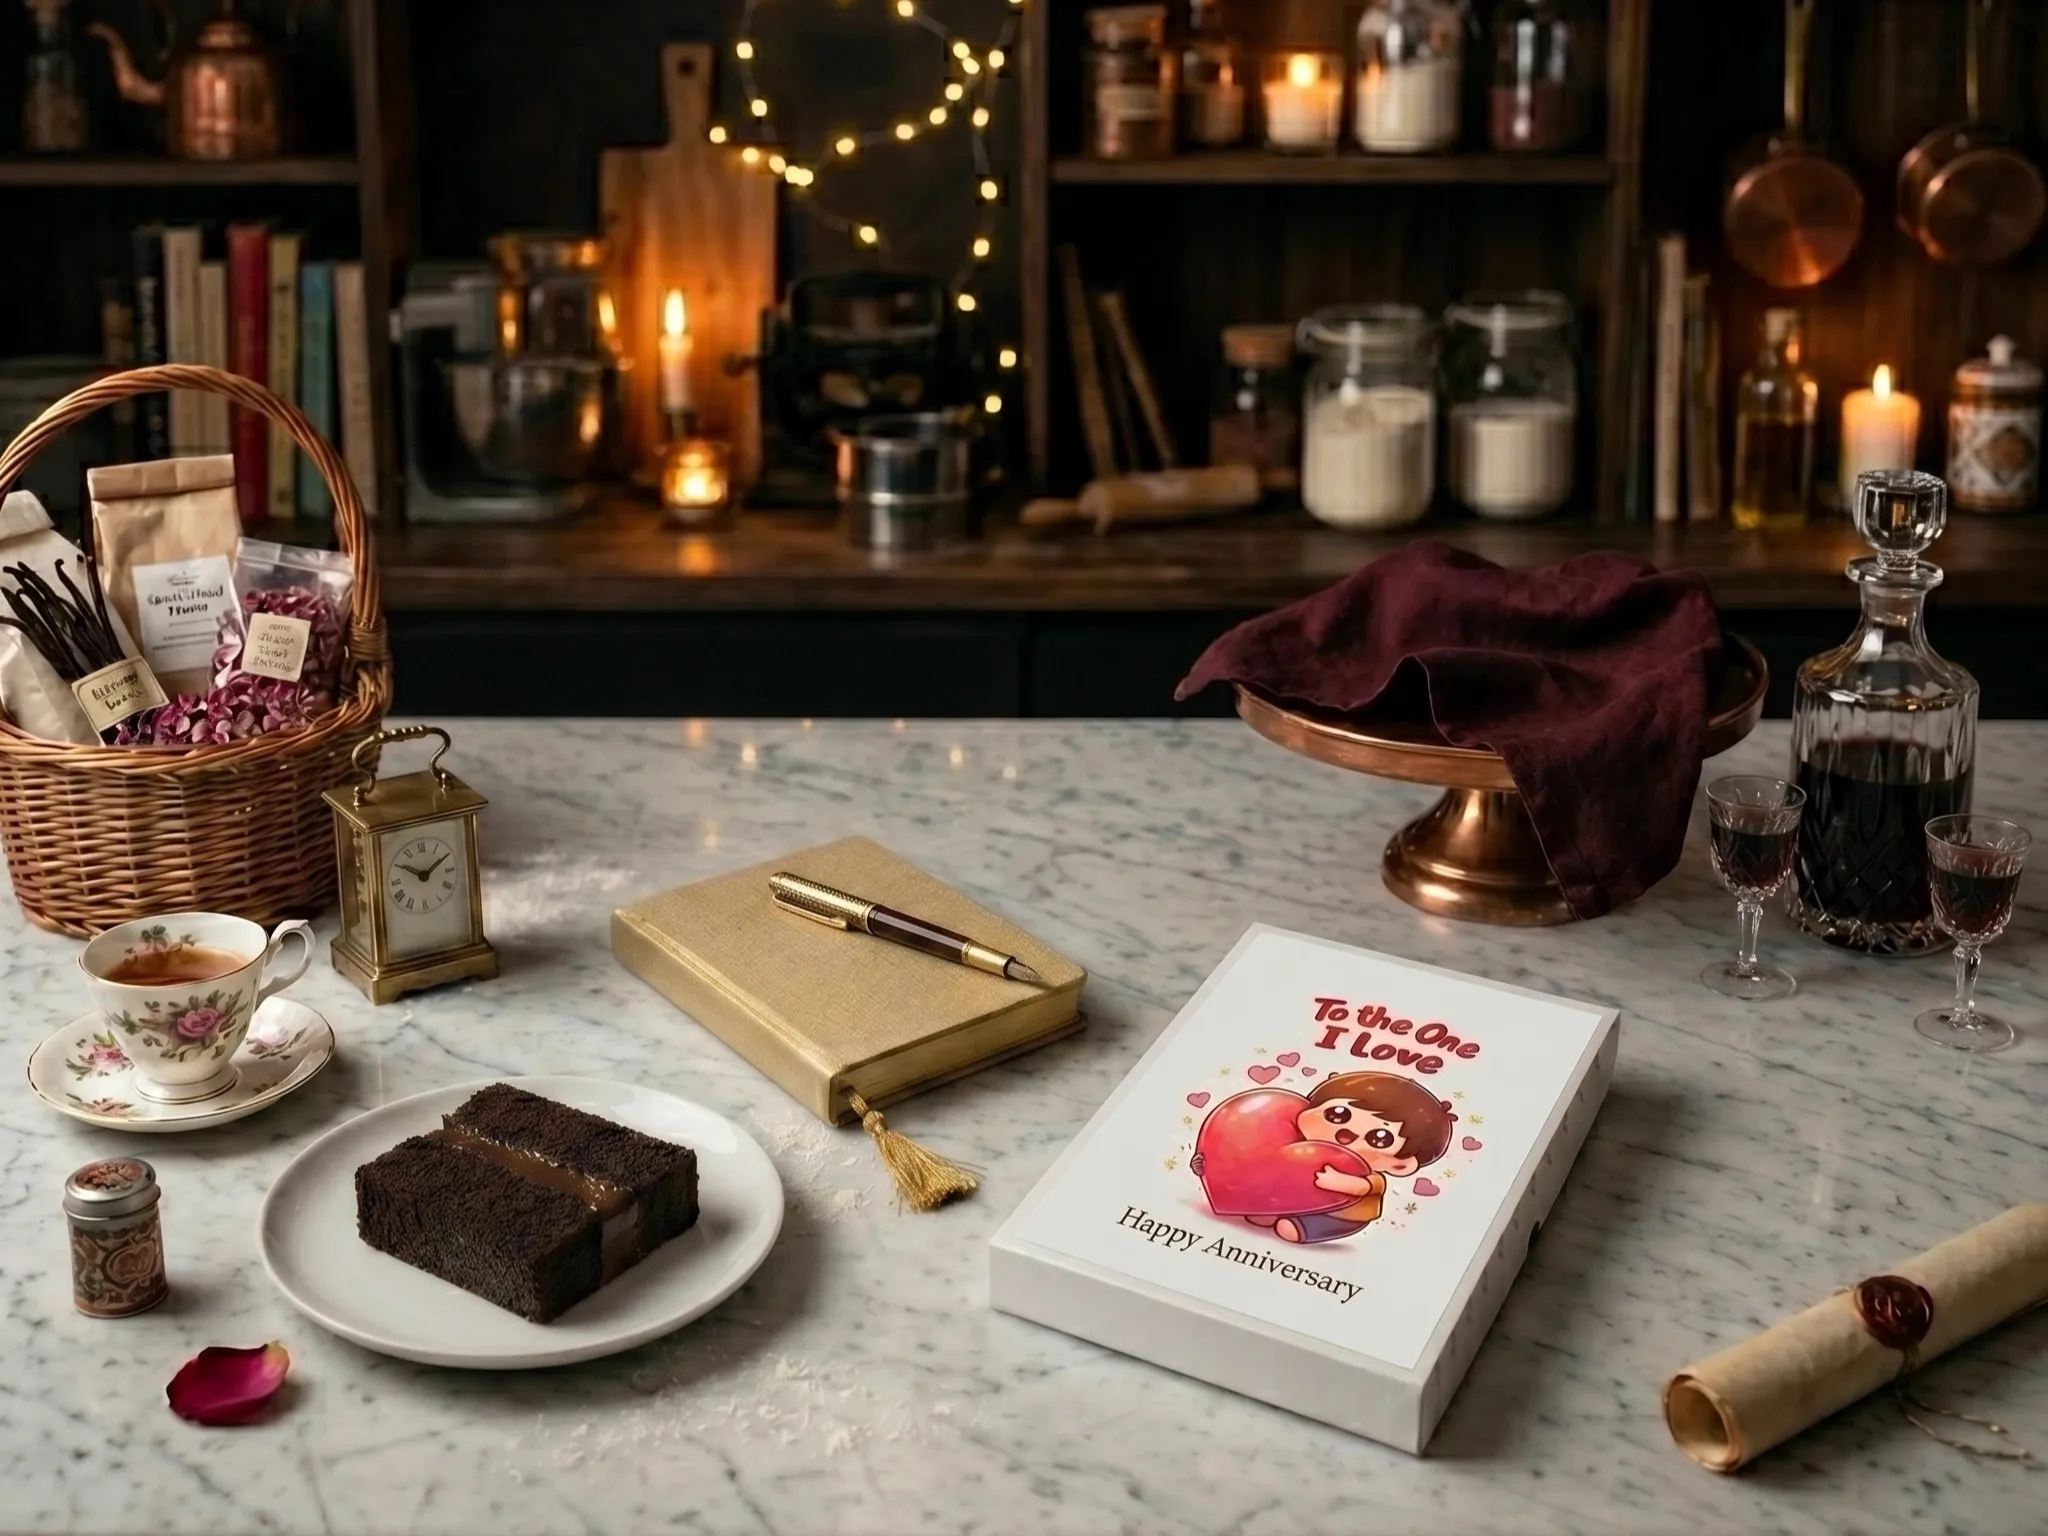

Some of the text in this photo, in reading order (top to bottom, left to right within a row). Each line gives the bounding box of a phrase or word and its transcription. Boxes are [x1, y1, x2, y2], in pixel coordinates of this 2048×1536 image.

[1314, 997, 1480, 1059] To the One
[1314, 1025, 1444, 1075] I Love
[1116, 1205, 1365, 1304] Happy Anniversary
